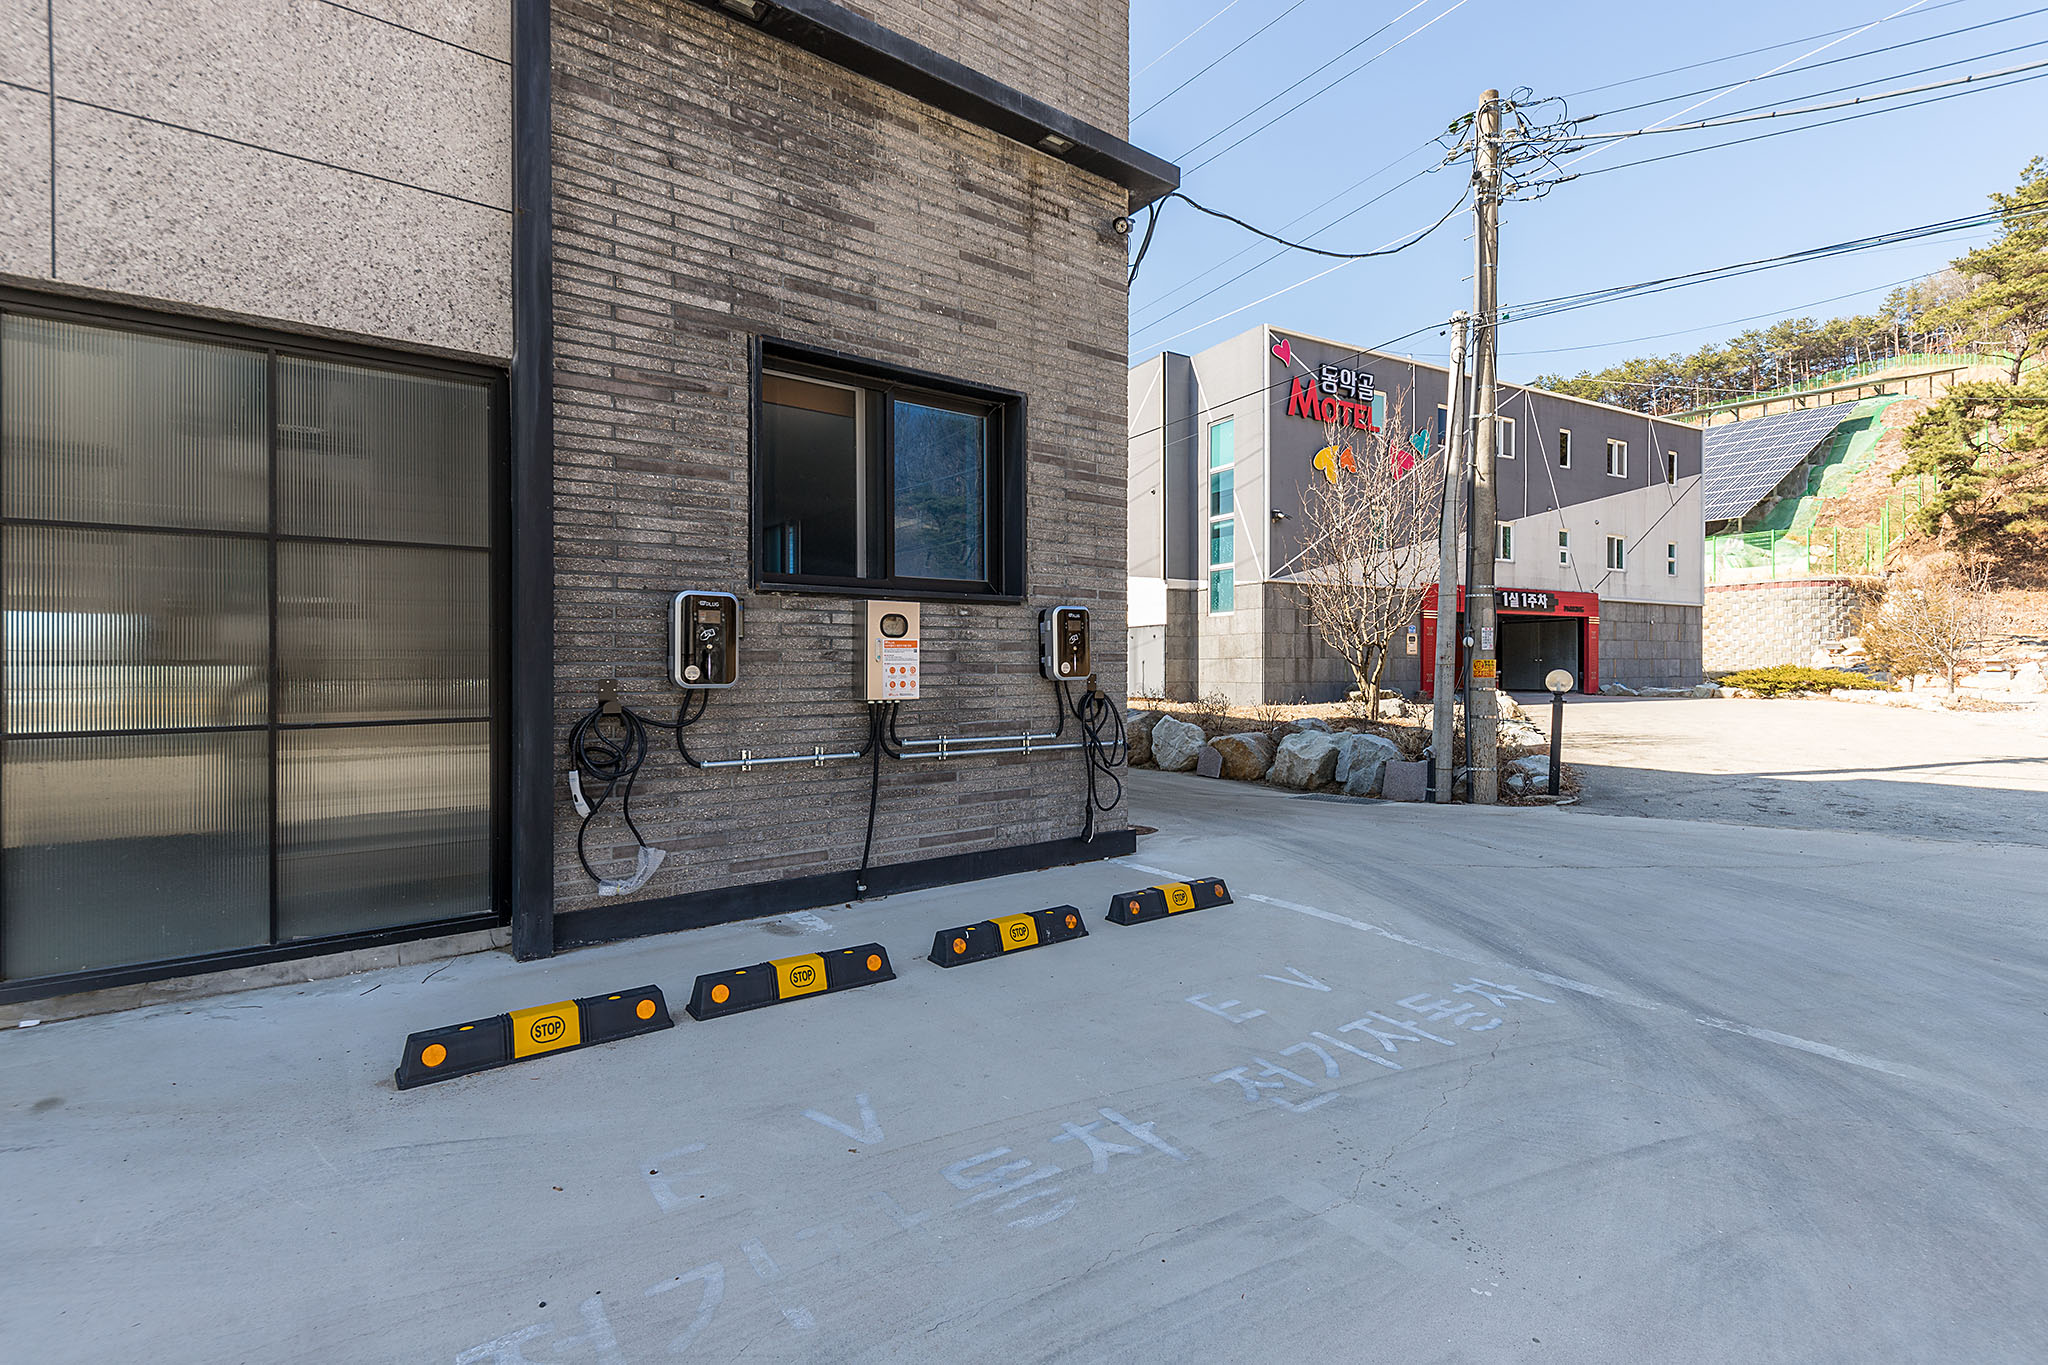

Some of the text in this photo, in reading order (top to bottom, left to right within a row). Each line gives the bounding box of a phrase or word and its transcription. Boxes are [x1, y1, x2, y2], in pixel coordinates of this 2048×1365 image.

[1288, 376, 1380, 433] MOTEL
[1502, 592, 1548, 609] 1실 1주차
[1175, 892, 1187, 903] STOP
[1012, 927, 1028, 938] STOP
[792, 968, 813, 983] STOP
[534, 1019, 562, 1037] STOP
[1209, 977, 1556, 1112] 전기자동차
